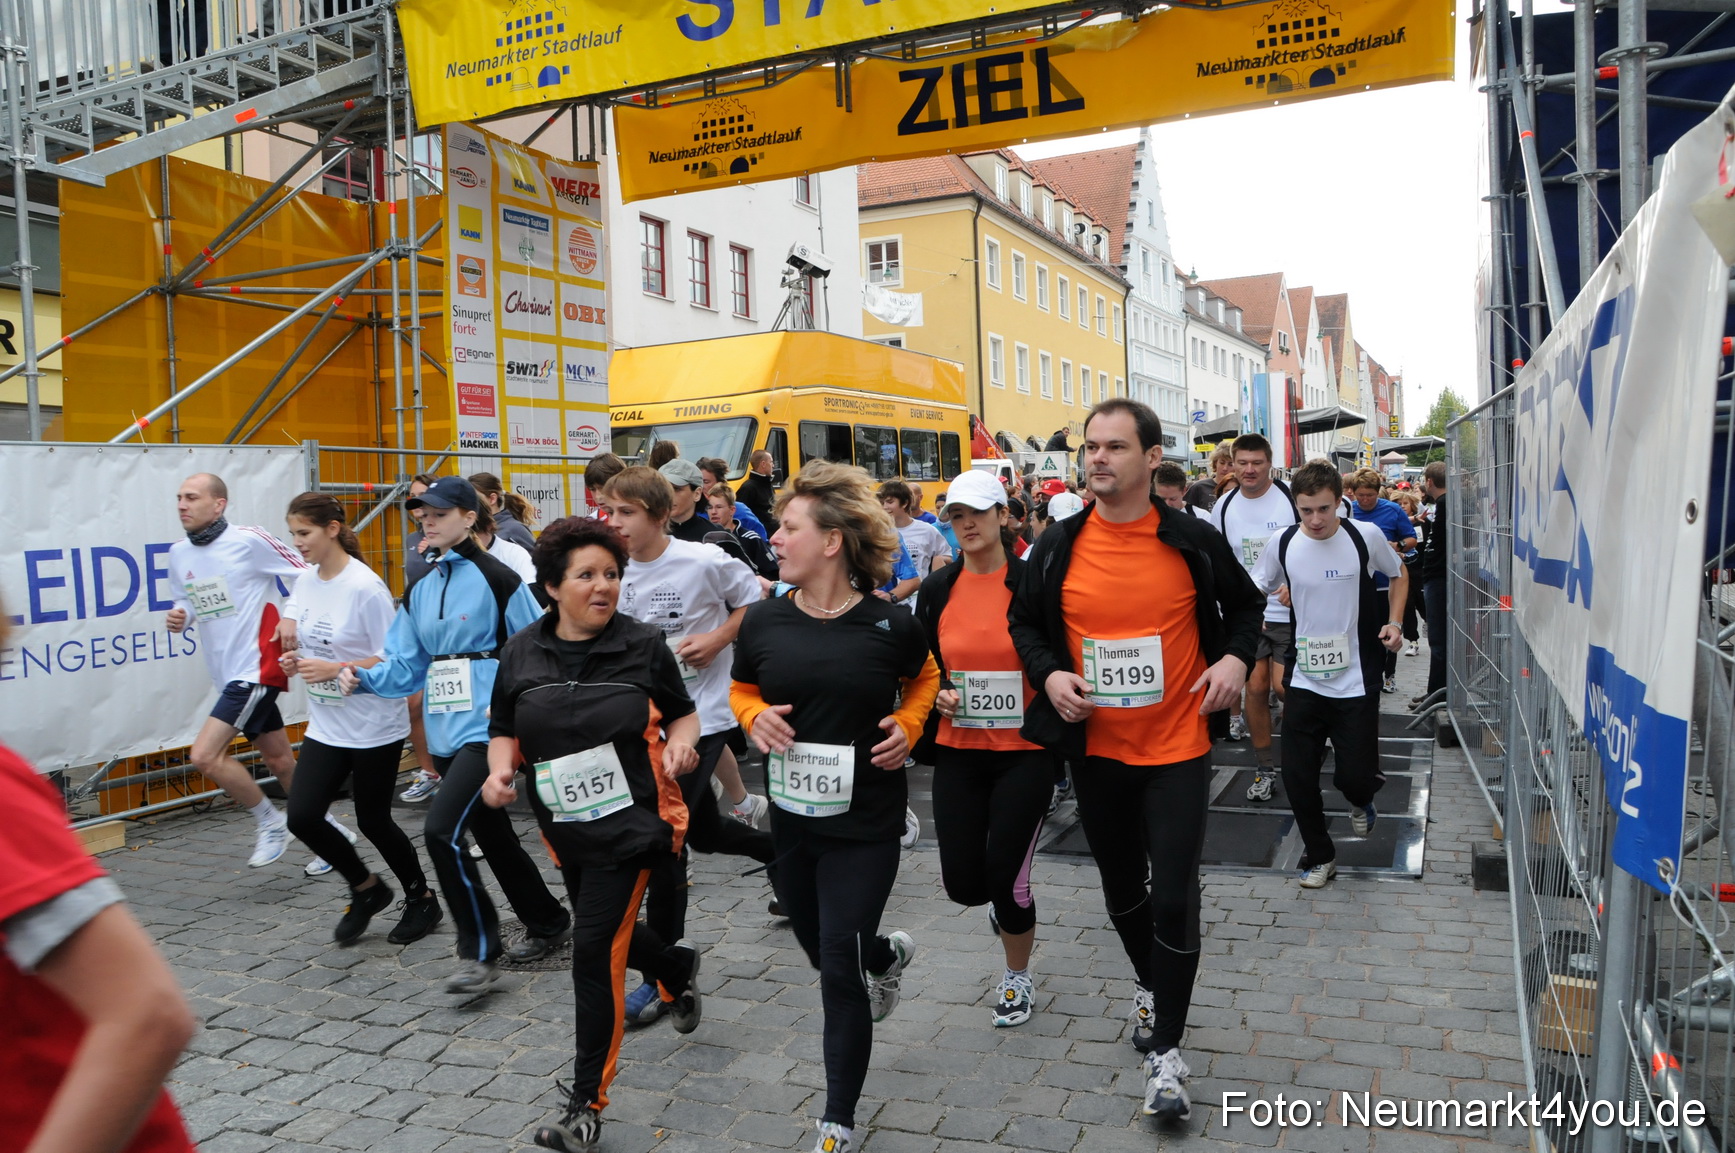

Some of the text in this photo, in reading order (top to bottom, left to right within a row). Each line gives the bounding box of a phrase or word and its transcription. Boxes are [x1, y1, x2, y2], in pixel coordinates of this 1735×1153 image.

[446, 24, 623, 79] Neumarkter Stadtlauf
[1196, 26, 1406, 78] Neumarkter Stadtlauf
[897, 46, 1086, 136] ZIEL
[648, 126, 802, 164] Neumarkter Stadtlauf
[513, 178, 536, 193] KANN
[550, 176, 600, 199] MERZ
[460, 228, 481, 240] KANN
[568, 246, 598, 259] WITTMANN
[452, 304, 491, 322] Sinupret
[563, 301, 606, 326] OBI
[453, 320, 477, 336] forte
[466, 348, 494, 359] Egner
[565, 363, 596, 381] MCM
[460, 385, 471, 393] GUT
[471, 385, 482, 394] FÜR
[673, 403, 732, 417] TIMING
[823, 396, 859, 409] SPORTRONIC
[910, 408, 944, 421] EVENT SERVICE
[465, 431, 498, 439] INTERSPORT
[542, 437, 559, 446] BÖGL
[568, 430, 595, 438] GERHART
[460, 439, 499, 449] HACKNER
[516, 485, 559, 503] Sinupret
[200, 592, 227, 607] 5134
[1308, 640, 1334, 650] Michael
[1098, 646, 1140, 660] Thomas
[1310, 651, 1343, 666] 5121
[1101, 665, 1155, 686] 5199
[434, 679, 463, 696] 5131
[968, 677, 989, 690] Nagi
[970, 694, 1016, 710] 5200
[787, 748, 840, 766] Gertraud
[564, 771, 615, 803] 5157
[789, 770, 842, 794] 5161
